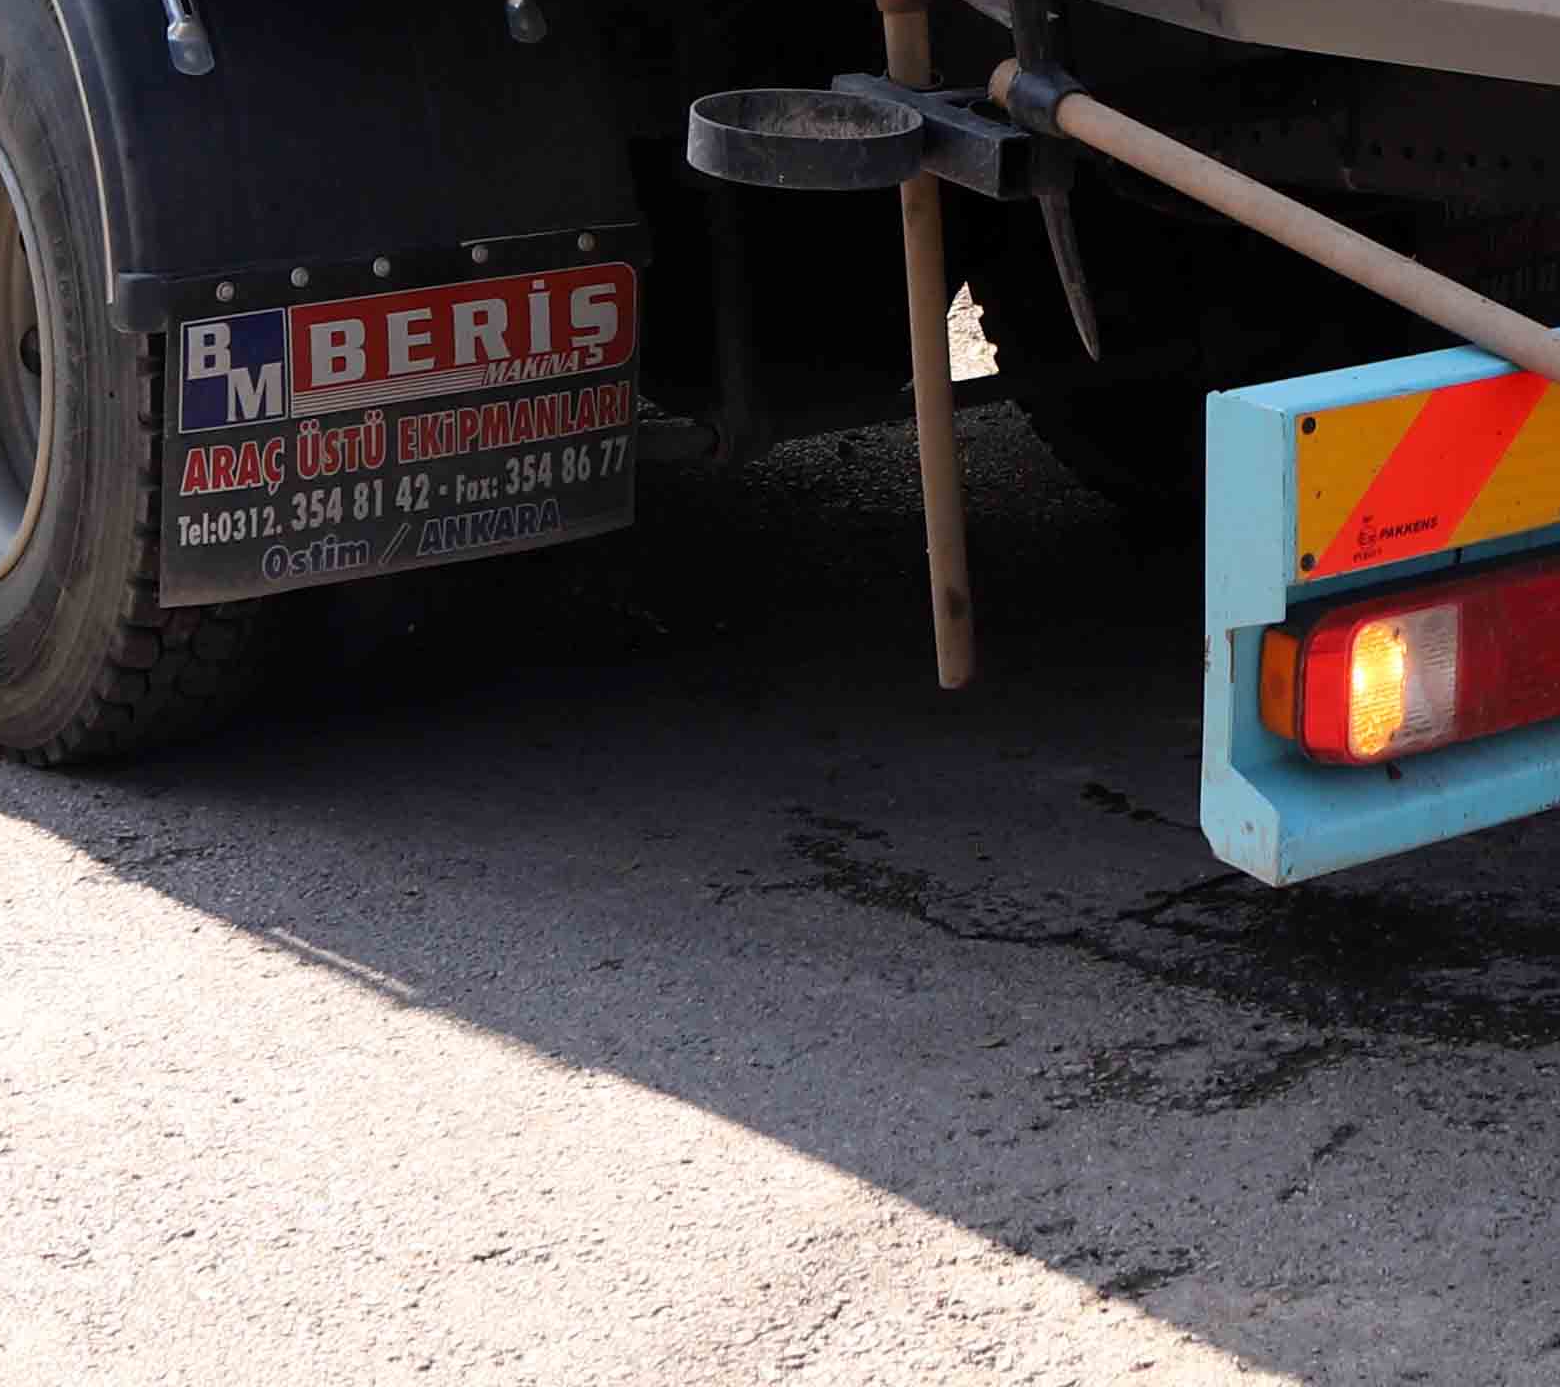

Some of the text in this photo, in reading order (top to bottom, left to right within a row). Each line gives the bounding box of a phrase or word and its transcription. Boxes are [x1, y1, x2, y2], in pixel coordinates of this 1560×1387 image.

[309, 279, 619, 389] BERİŞ
[179, 436, 286, 497] ARAÇ
[296, 409, 387, 480] ÜSTÜ
[291, 485, 344, 532] 354
[352, 478, 384, 521] 81
[394, 472, 430, 513] 42
[455, 473, 499, 505] Fax:
[504, 456, 553, 495] 354
[561, 445, 592, 484] 86
[599, 435, 629, 476] 77
[262, 533, 371, 580] Ostim
[417, 498, 560, 556] ANKARA
